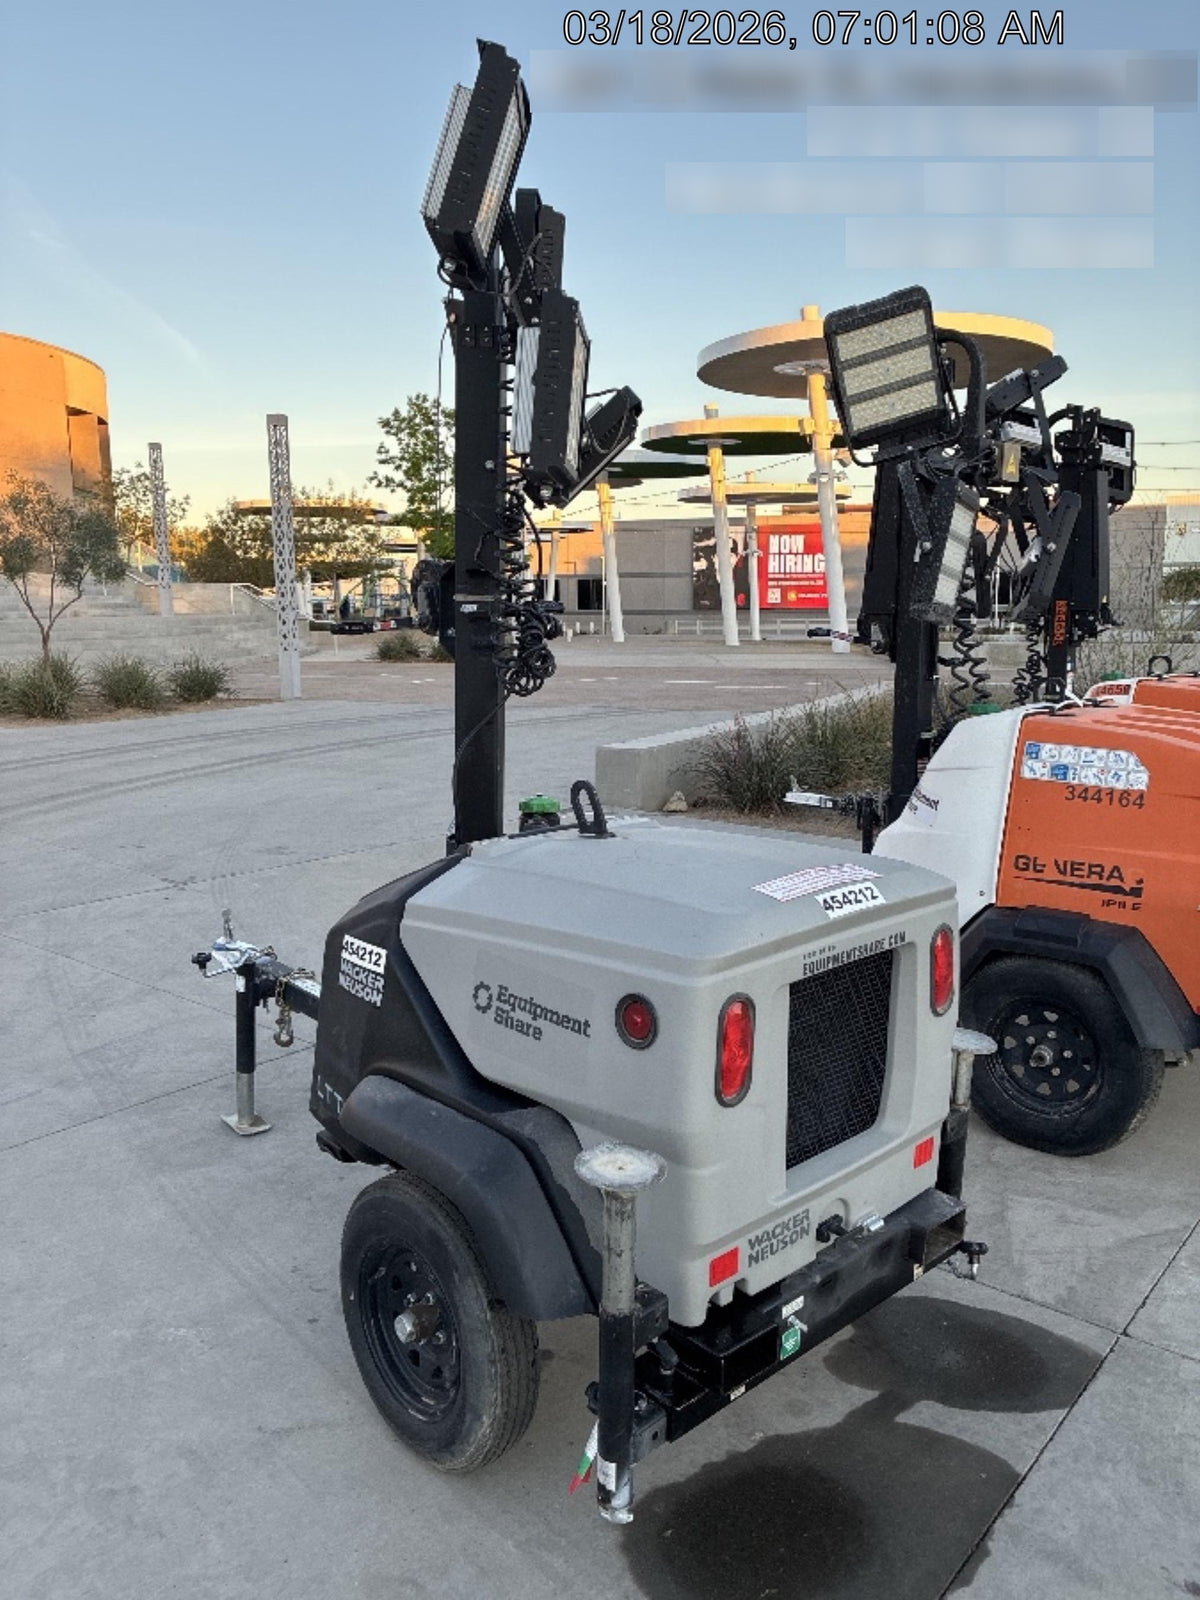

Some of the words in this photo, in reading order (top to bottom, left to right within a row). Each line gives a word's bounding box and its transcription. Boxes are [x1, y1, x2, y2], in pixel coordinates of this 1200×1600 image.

[768, 535, 805, 554] NOW
[767, 553, 826, 573] HIRING
[1064, 786, 1146, 809] 344164
[823, 887, 879, 911] 454212
[342, 940, 382, 967] 454212
[493, 1008, 543, 1041] Share
[495, 984, 592, 1038] Equipment
[748, 1209, 810, 1251] WACKER
[748, 1223, 810, 1268] NEUSON
